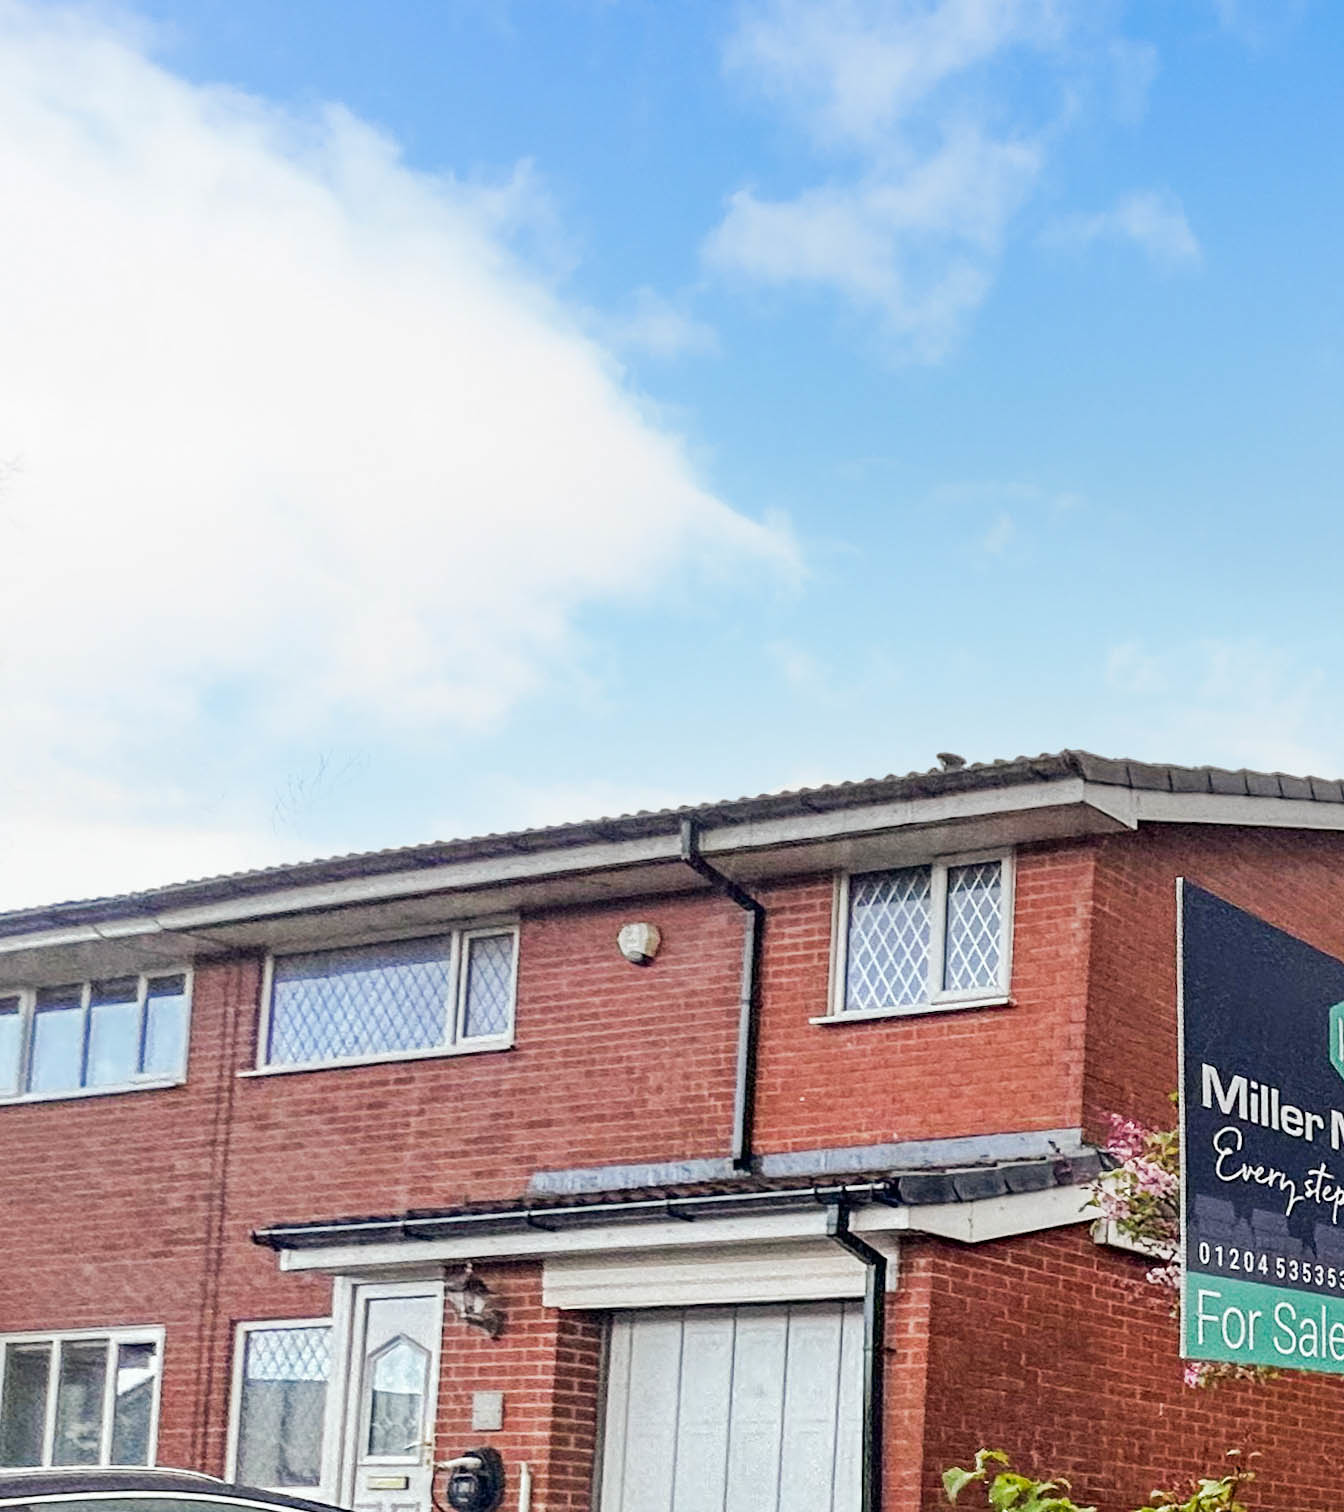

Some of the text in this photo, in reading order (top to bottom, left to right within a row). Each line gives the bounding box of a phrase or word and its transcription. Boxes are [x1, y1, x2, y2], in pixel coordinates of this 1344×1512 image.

[1201, 1062, 1325, 1142] Miller
[1212, 1126, 1306, 1217] Every
[1199, 1241, 1269, 1276] 01204
[1197, 1288, 1262, 1351] For
